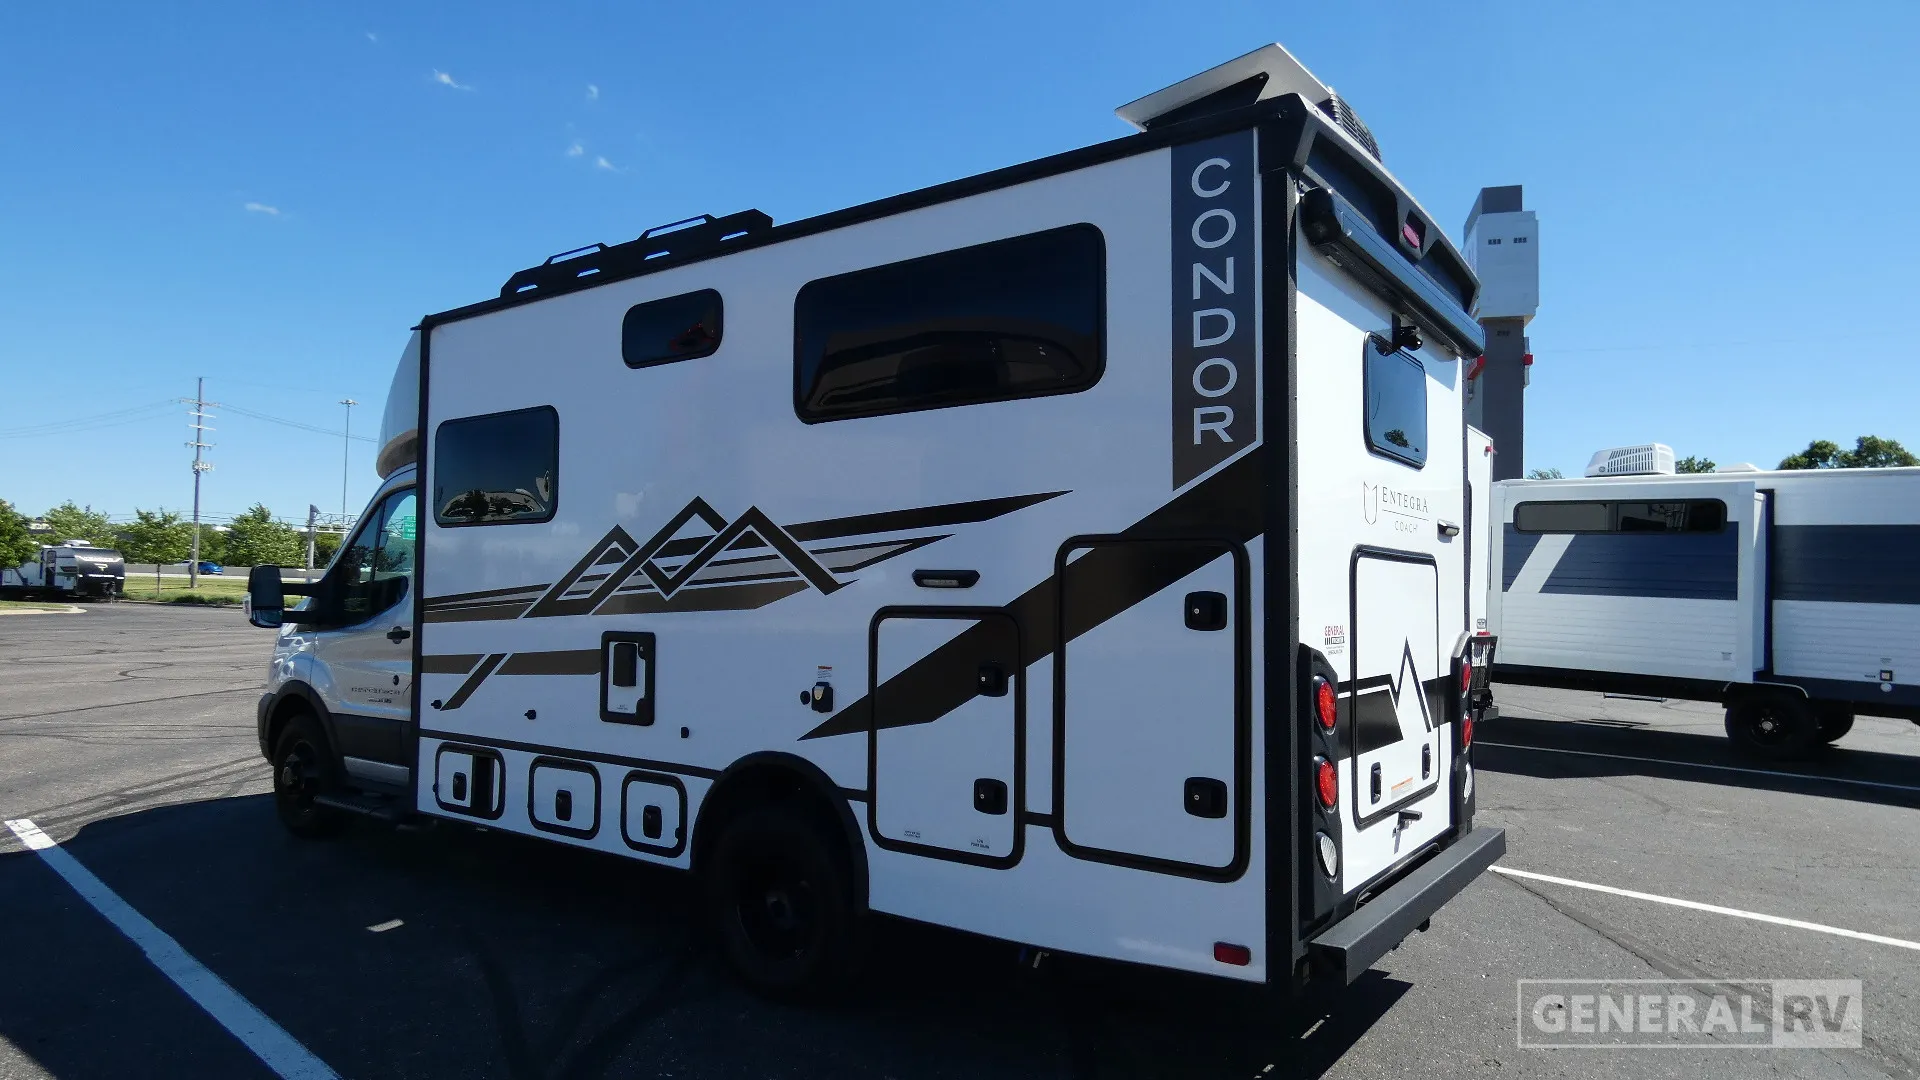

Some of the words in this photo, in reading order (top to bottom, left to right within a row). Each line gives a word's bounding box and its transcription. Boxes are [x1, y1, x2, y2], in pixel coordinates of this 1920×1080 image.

[1190, 156, 1238, 446] CONDOR
[1382, 486, 1429, 514] ENTEGRA
[1394, 520, 1418, 534] COACH
